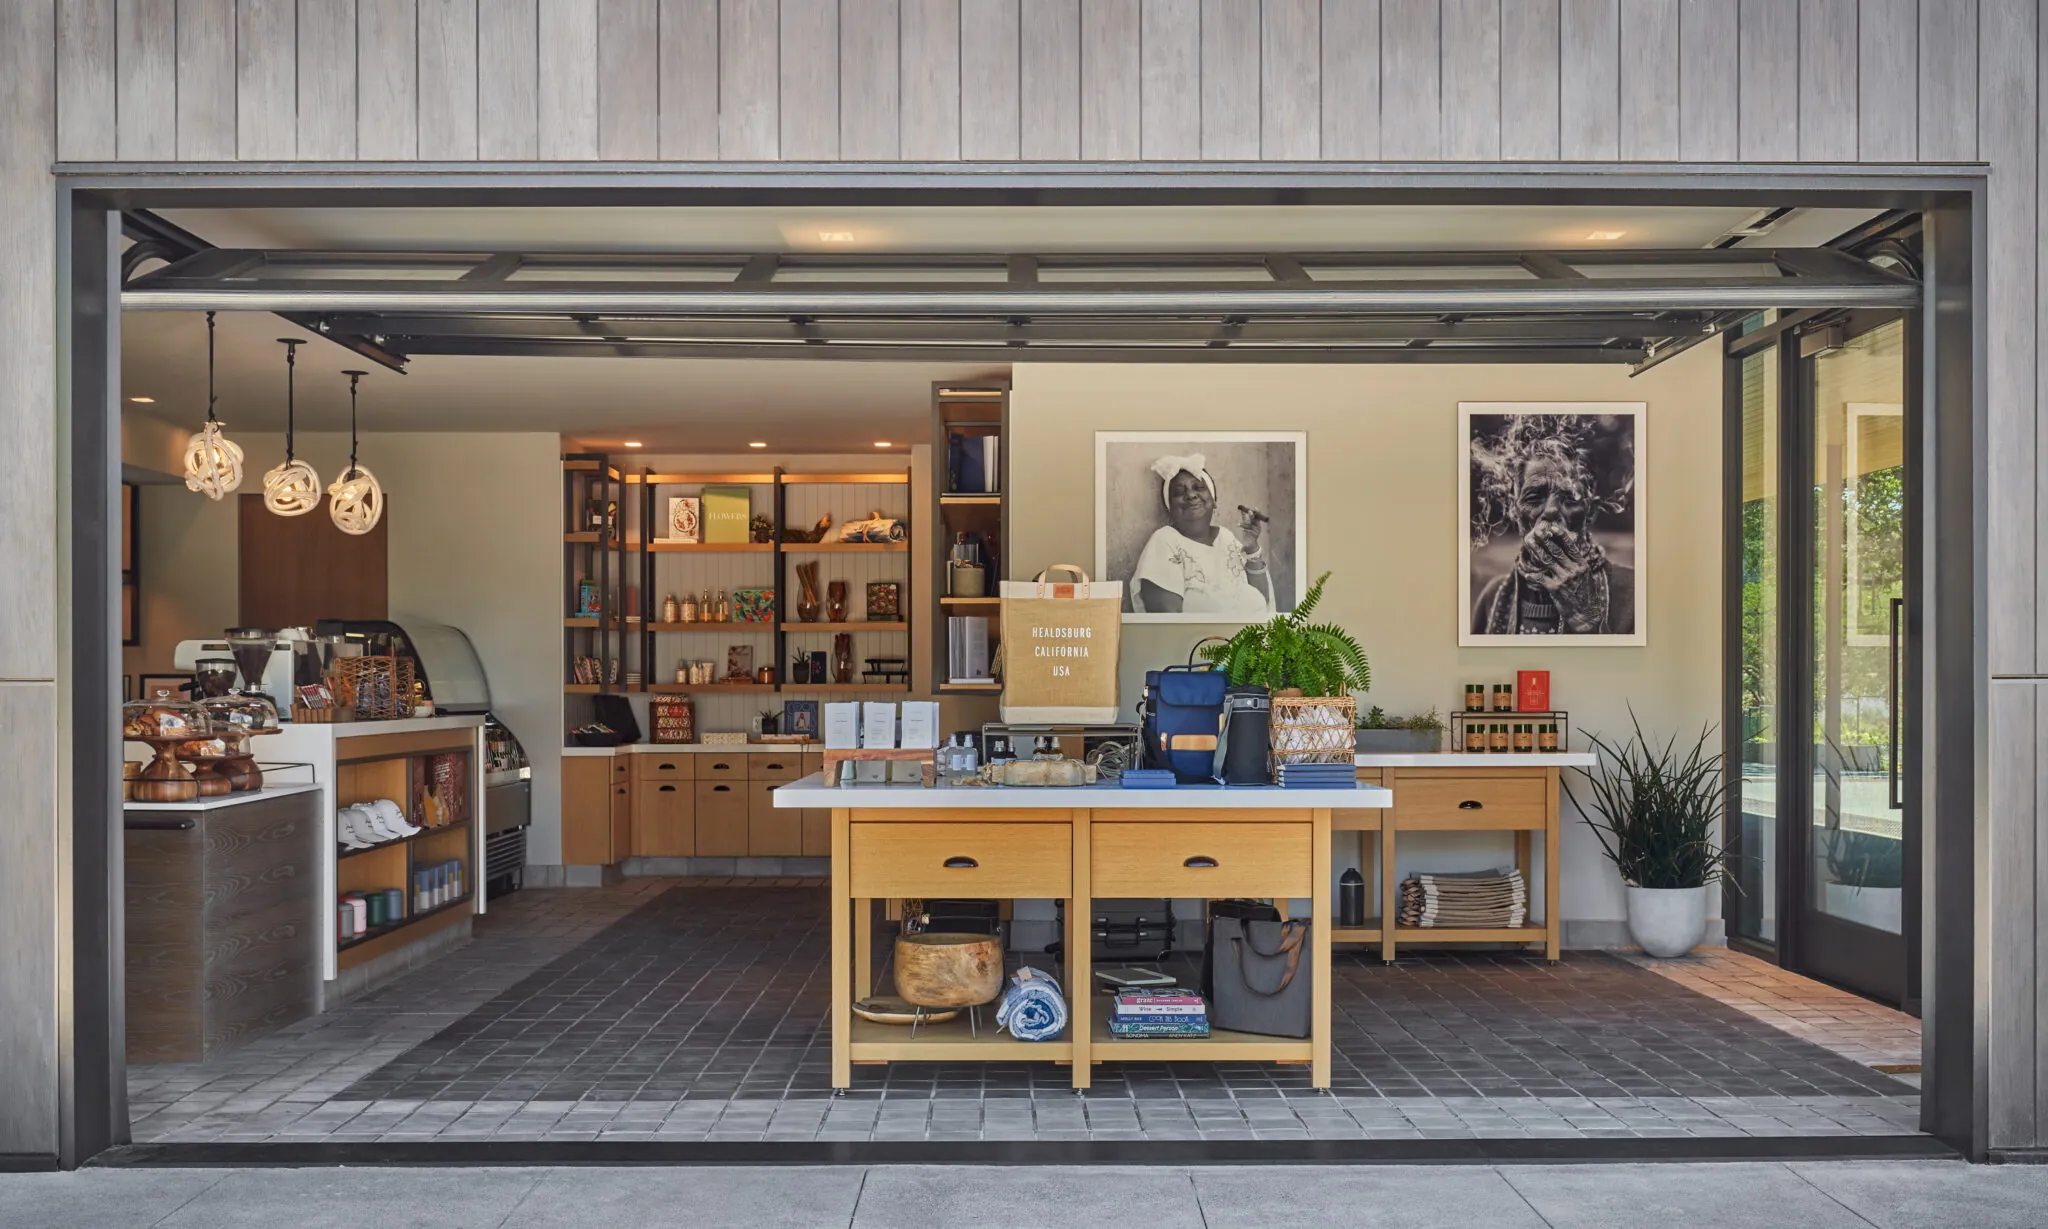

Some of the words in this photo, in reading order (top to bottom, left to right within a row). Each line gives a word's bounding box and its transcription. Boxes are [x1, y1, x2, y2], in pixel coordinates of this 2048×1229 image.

[709, 512, 747, 520] FLOWERS
[1032, 627, 1092, 638] HEALDSBURG
[1034, 646, 1089, 658] CALIFORNIA
[1053, 666, 1070, 676] USA
